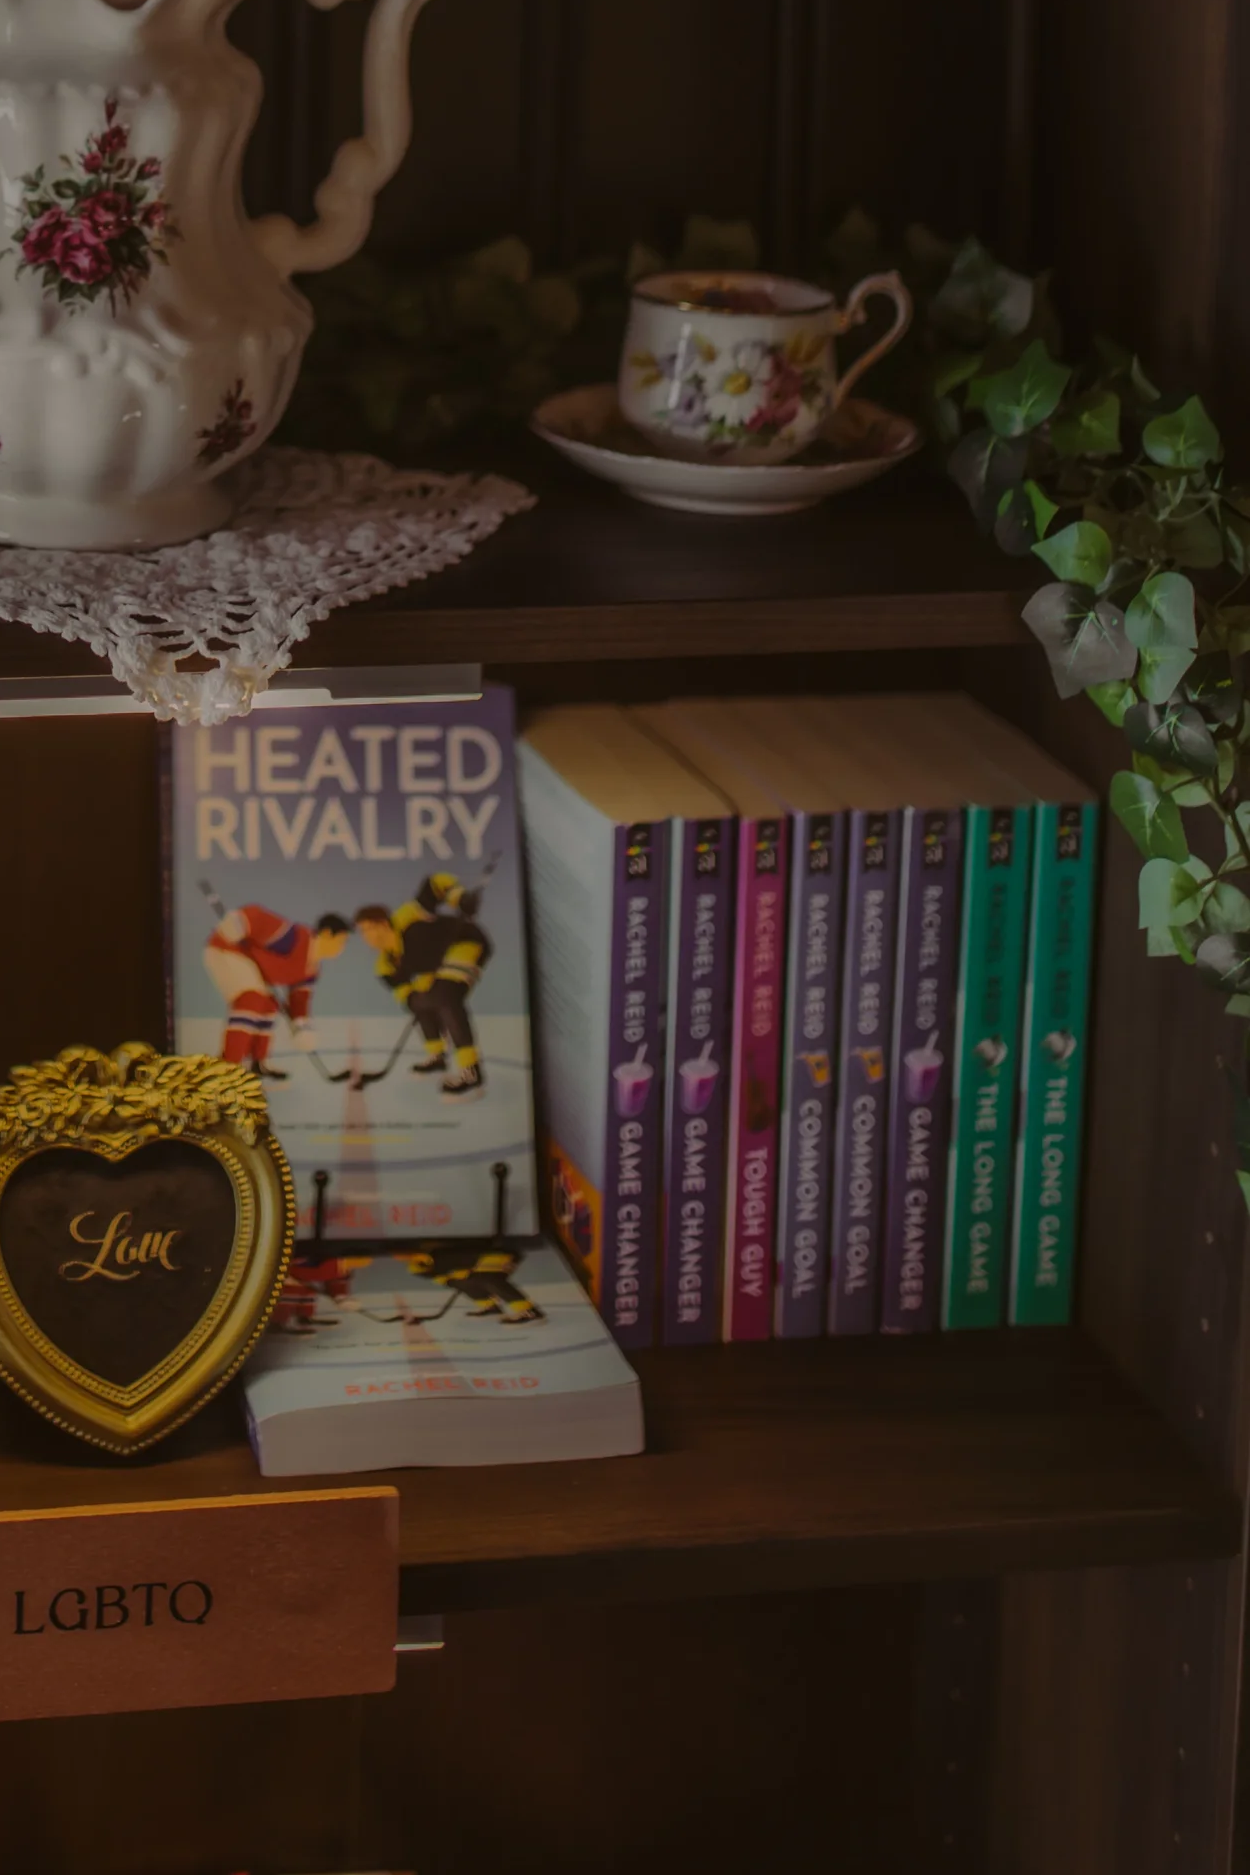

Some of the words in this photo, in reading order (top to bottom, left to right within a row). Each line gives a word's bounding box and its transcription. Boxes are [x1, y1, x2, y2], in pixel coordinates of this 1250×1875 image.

[195, 725, 503, 794] HEATED
[196, 795, 501, 861] RIVALRY
[626, 897, 647, 982] RACHEL
[693, 894, 716, 979] RACHEL
[807, 893, 828, 979] RACHEL
[920, 886, 942, 970] RACHEL
[624, 991, 645, 1041] REID
[691, 988, 711, 1037] REID
[804, 987, 825, 1037] REID
[917, 979, 937, 1028] REID
[976, 1083, 998, 1131] THE
[1044, 1077, 1067, 1125] THE
[618, 1122, 642, 1195] GAME
[682, 1118, 707, 1192] GAME
[797, 1099, 822, 1220] COMMON
[851, 1096, 875, 1216] COMMON
[907, 1107, 931, 1180] GAME
[972, 1141, 994, 1213] LONG
[1040, 1134, 1064, 1206] LONG
[743, 1148, 767, 1235] TOUGH
[58, 1210, 182, 1281] Love
[615, 1204, 640, 1324] CHANGER
[678, 1200, 704, 1321] CHANGER
[740, 1243, 764, 1296] GUY
[793, 1229, 817, 1298] GOAL
[846, 1225, 869, 1294] GOAL
[900, 1189, 927, 1309] CHANGER
[967, 1222, 990, 1293] GAME
[1035, 1216, 1060, 1287] GAME
[344, 1376, 462, 1396] RACHEL
[470, 1376, 540, 1393] REID
[14, 1580, 213, 1634] LGBTQ
